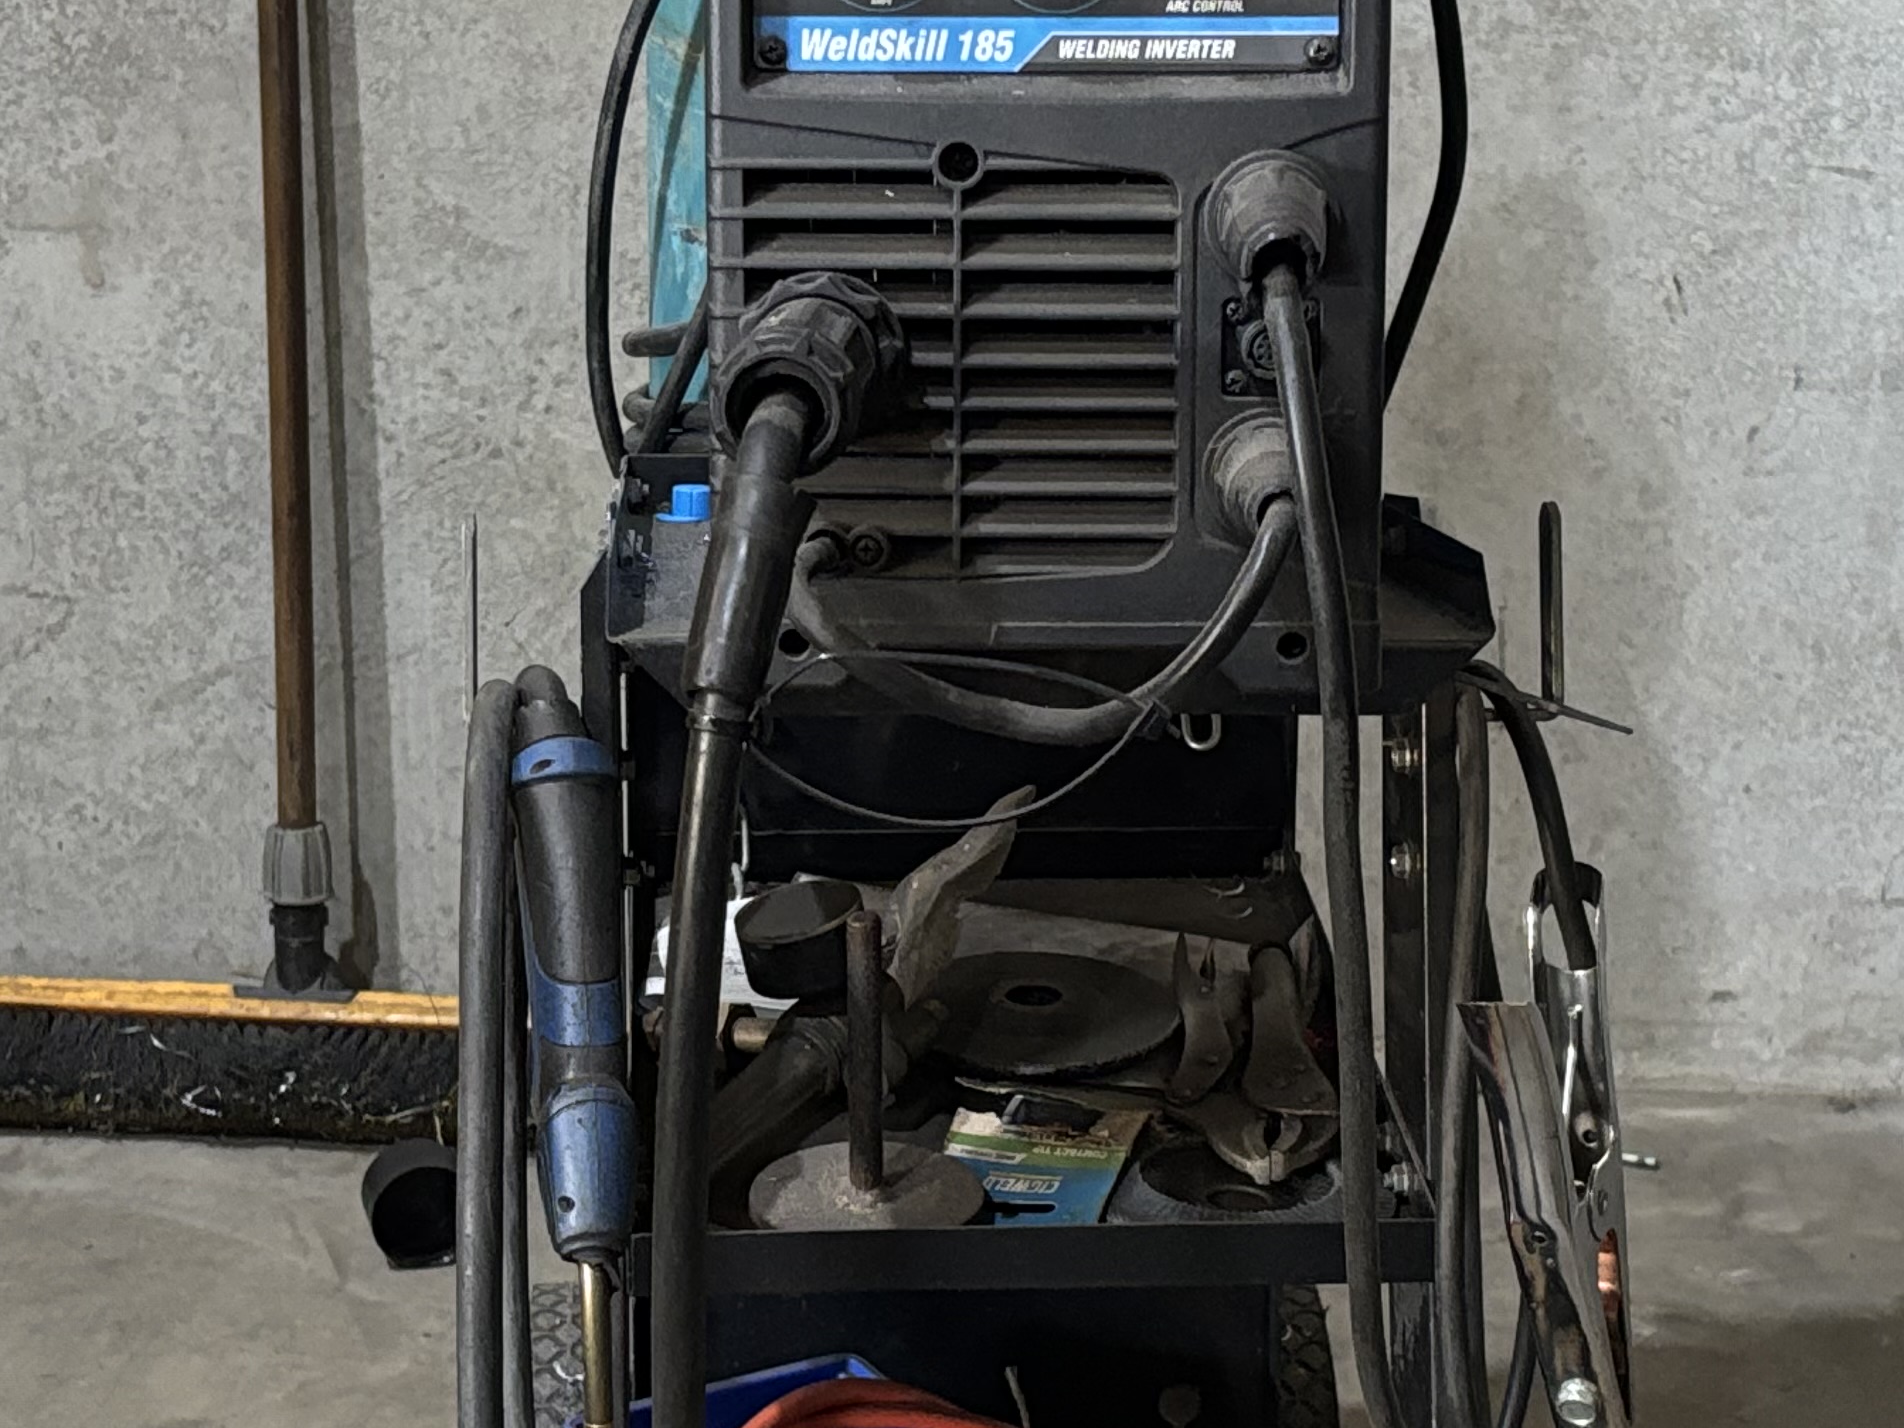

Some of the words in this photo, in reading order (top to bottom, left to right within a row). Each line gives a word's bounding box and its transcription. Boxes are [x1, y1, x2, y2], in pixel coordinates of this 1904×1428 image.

[1165, 0, 1191, 13] ARC
[1192, 0, 1244, 13] CONTROL
[800, 27, 949, 61] WeldSkill
[958, 28, 1015, 62] 185
[1059, 39, 1141, 59] WELDING
[1145, 39, 1236, 59] INVERTER
[1032, 1146, 1052, 1155] TIP
[1053, 1146, 1109, 1160] CONTACT
[982, 1175, 1061, 1194] CIGWELD
